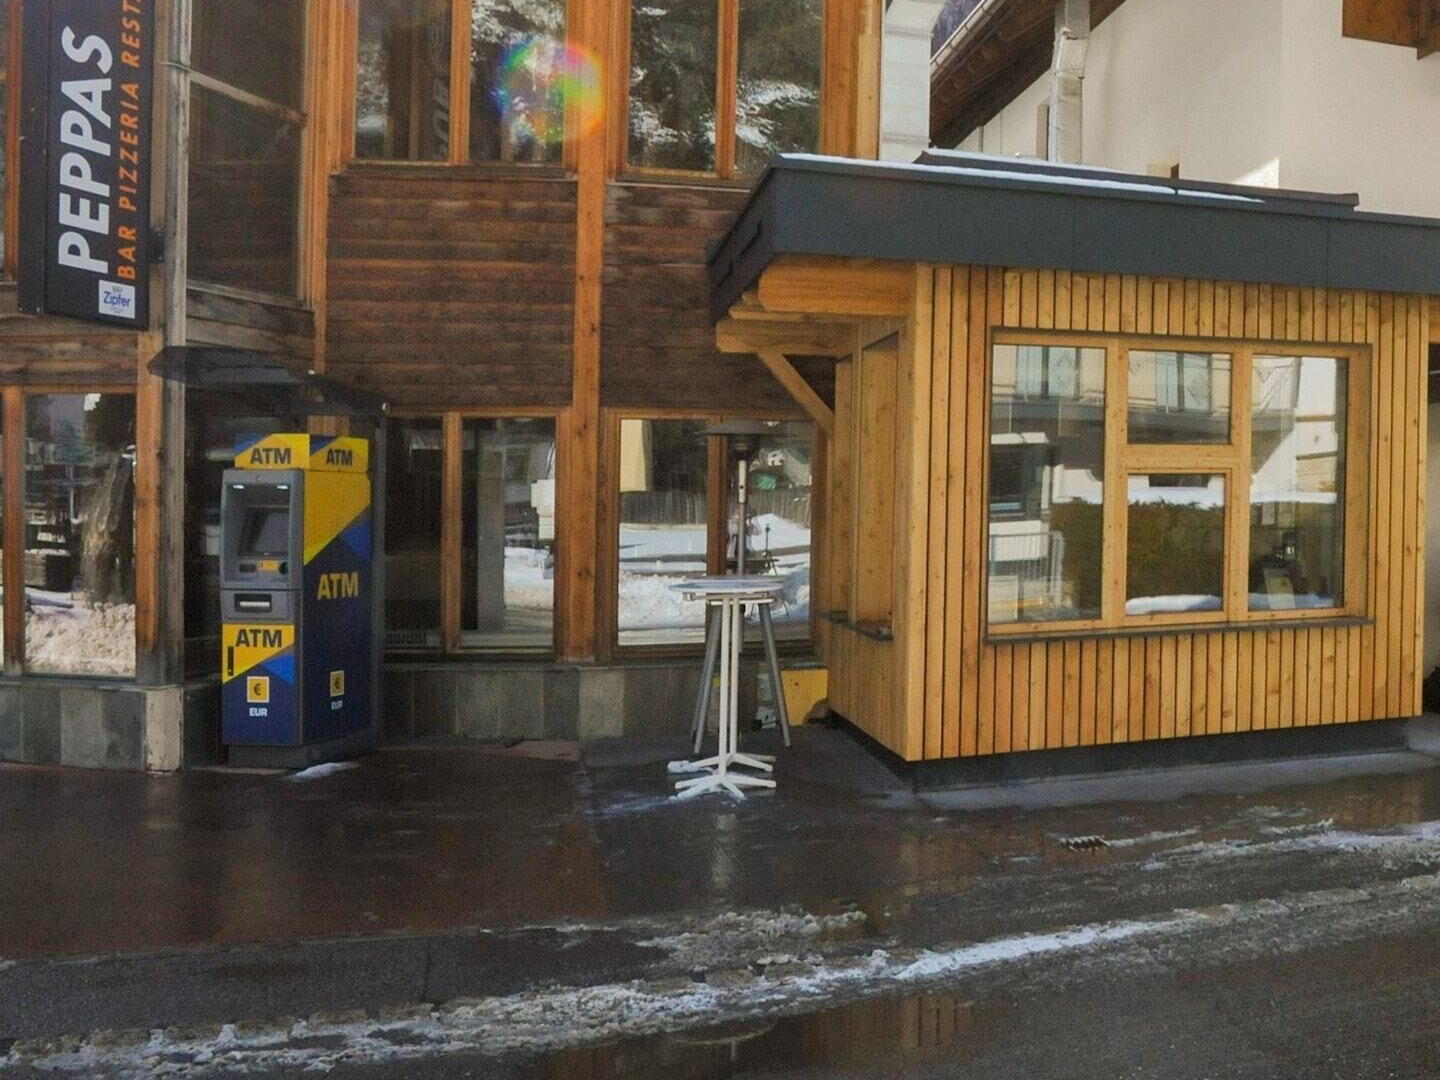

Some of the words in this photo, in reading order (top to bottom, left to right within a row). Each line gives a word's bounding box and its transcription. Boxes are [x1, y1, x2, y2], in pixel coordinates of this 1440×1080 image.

[58, 25, 113, 274] PEPPAS
[118, 83, 139, 211] PIZZERIA
[117, 225, 136, 280] BAR
[250, 448, 292, 465] ATM
[326, 448, 353, 466] ATM
[317, 572, 359, 600] ATM
[235, 629, 282, 648] ATM
[249, 707, 268, 717] EUR
